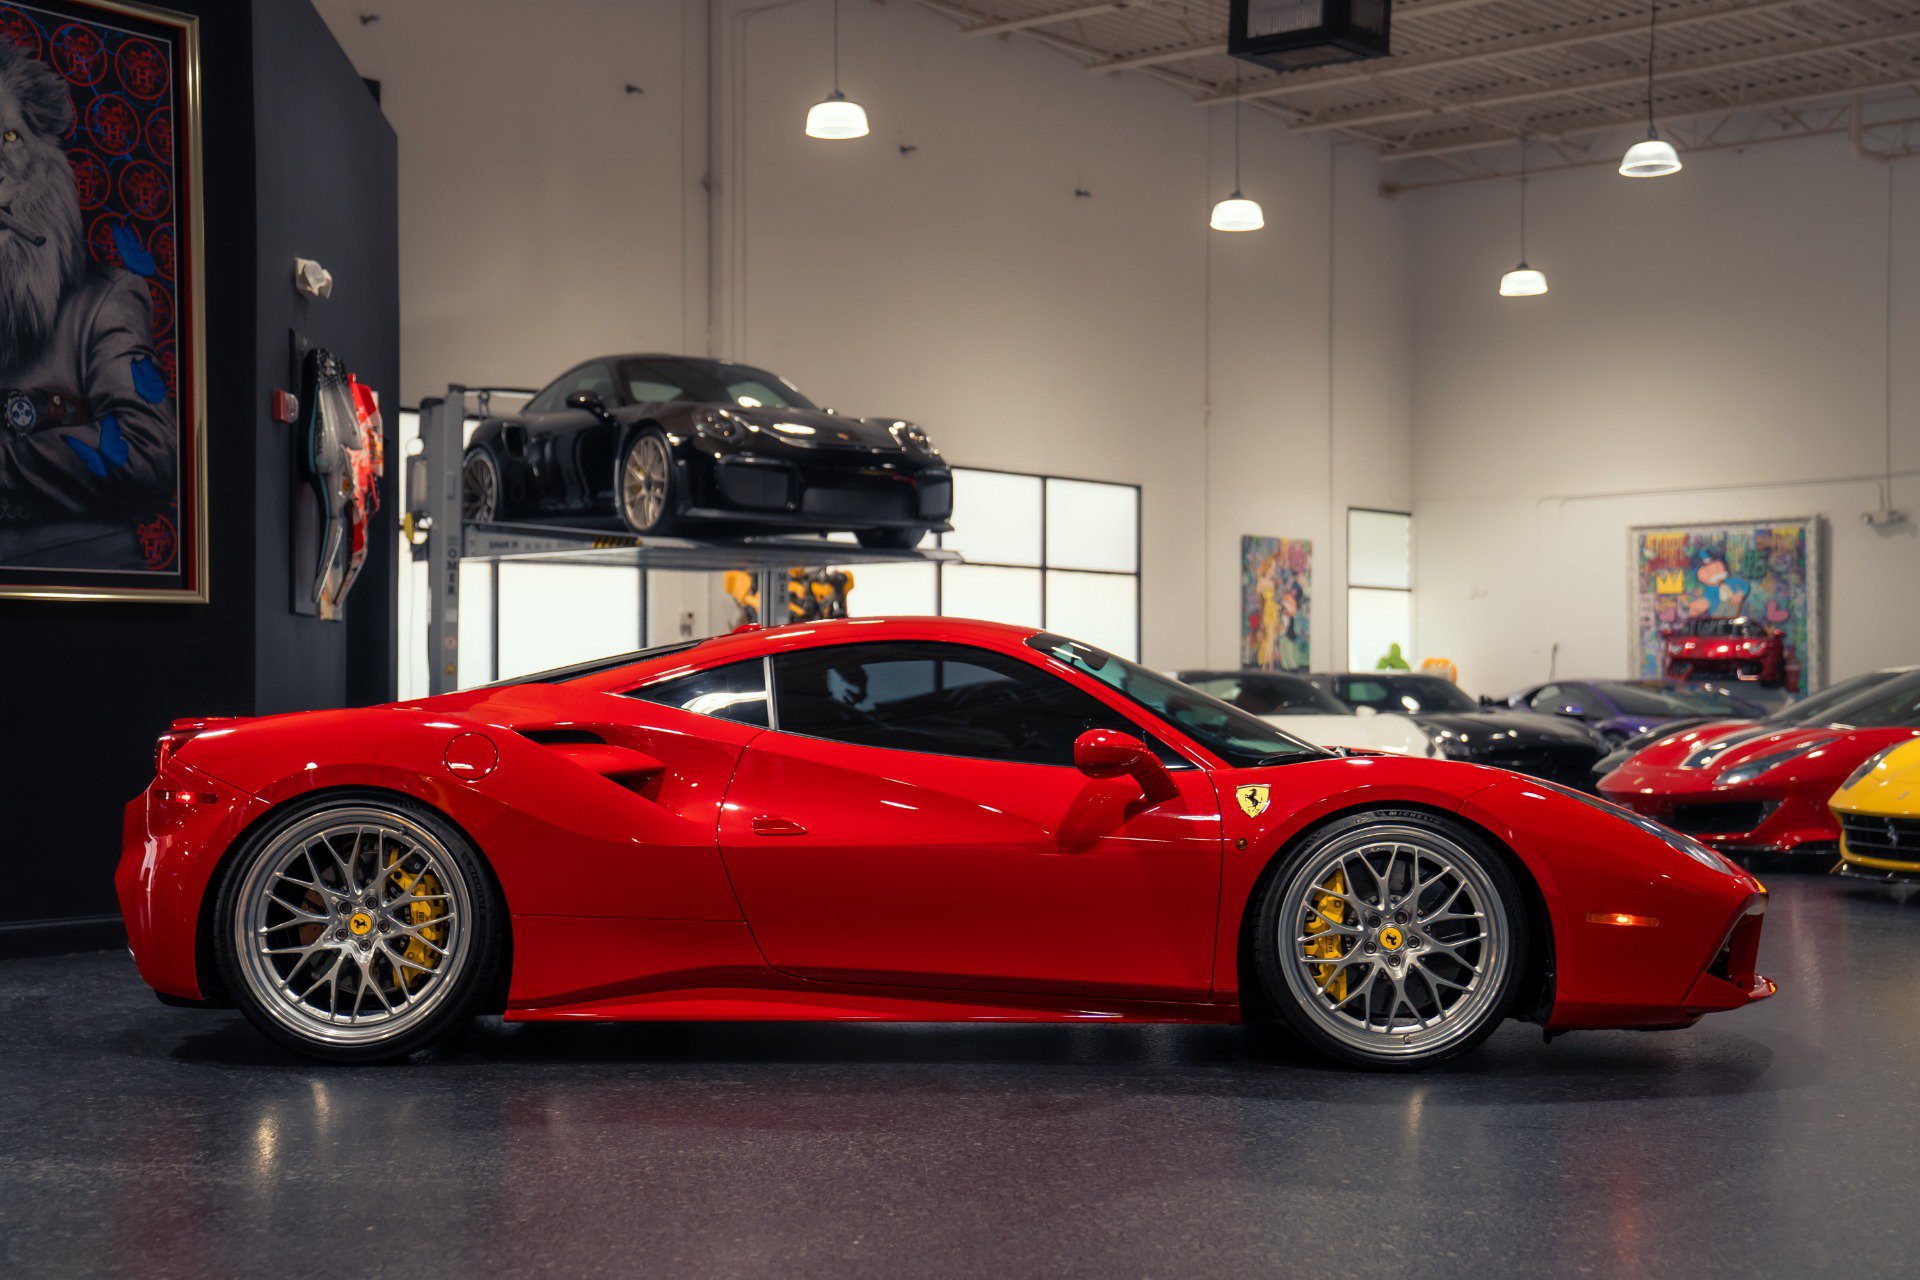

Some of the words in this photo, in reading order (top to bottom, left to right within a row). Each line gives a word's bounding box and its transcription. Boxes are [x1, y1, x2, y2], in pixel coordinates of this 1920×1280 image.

[135, 67, 150, 88] H
[106, 123, 123, 143] H
[447, 548, 457, 596] OMER
